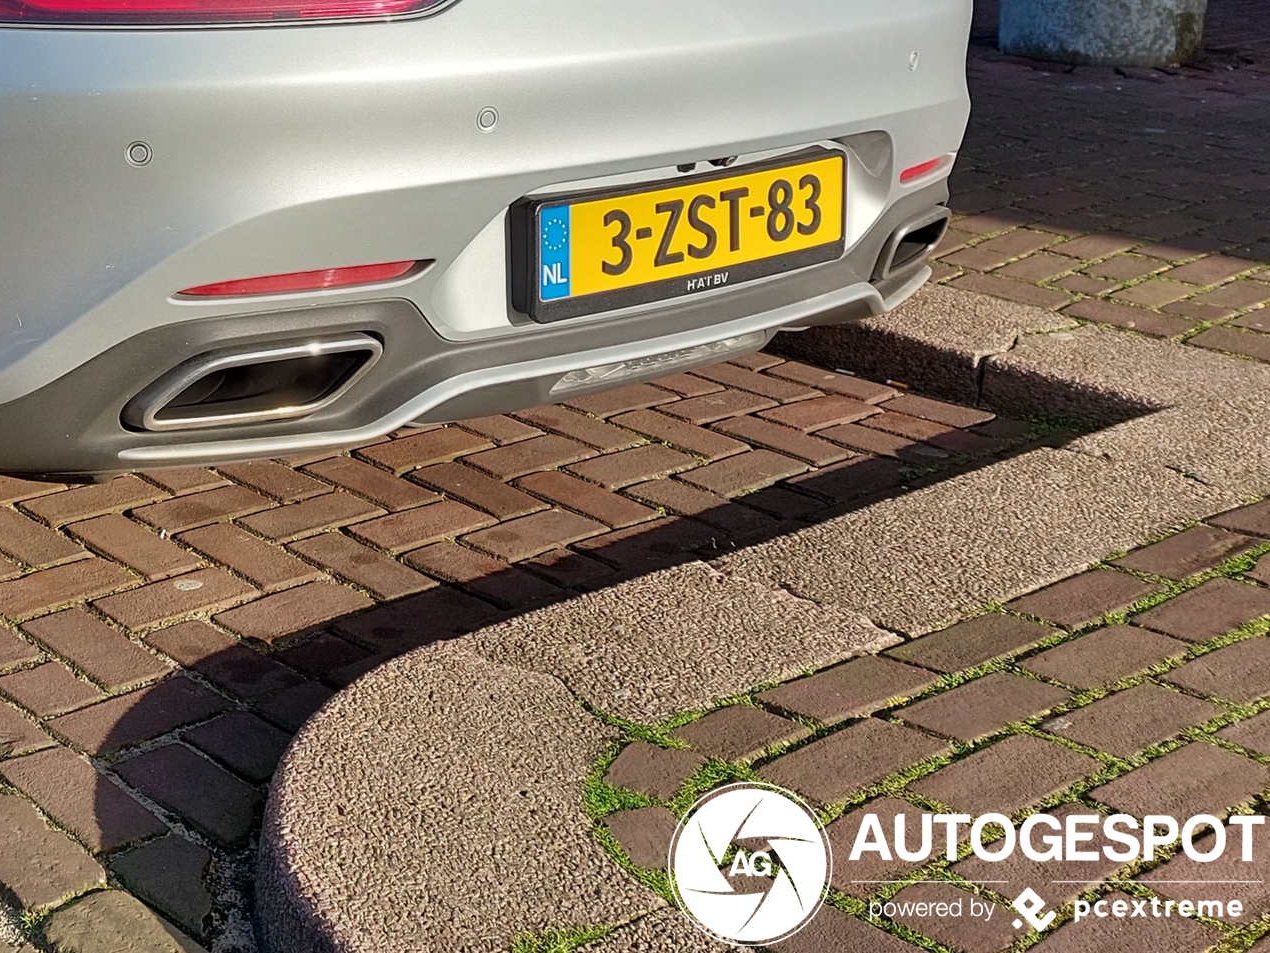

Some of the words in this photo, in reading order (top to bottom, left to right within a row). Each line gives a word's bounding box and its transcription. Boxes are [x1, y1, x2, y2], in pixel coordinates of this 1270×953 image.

[602, 174, 822, 277] 3-ZST-83
[543, 263, 567, 286] NL
[714, 271, 729, 285] BV
